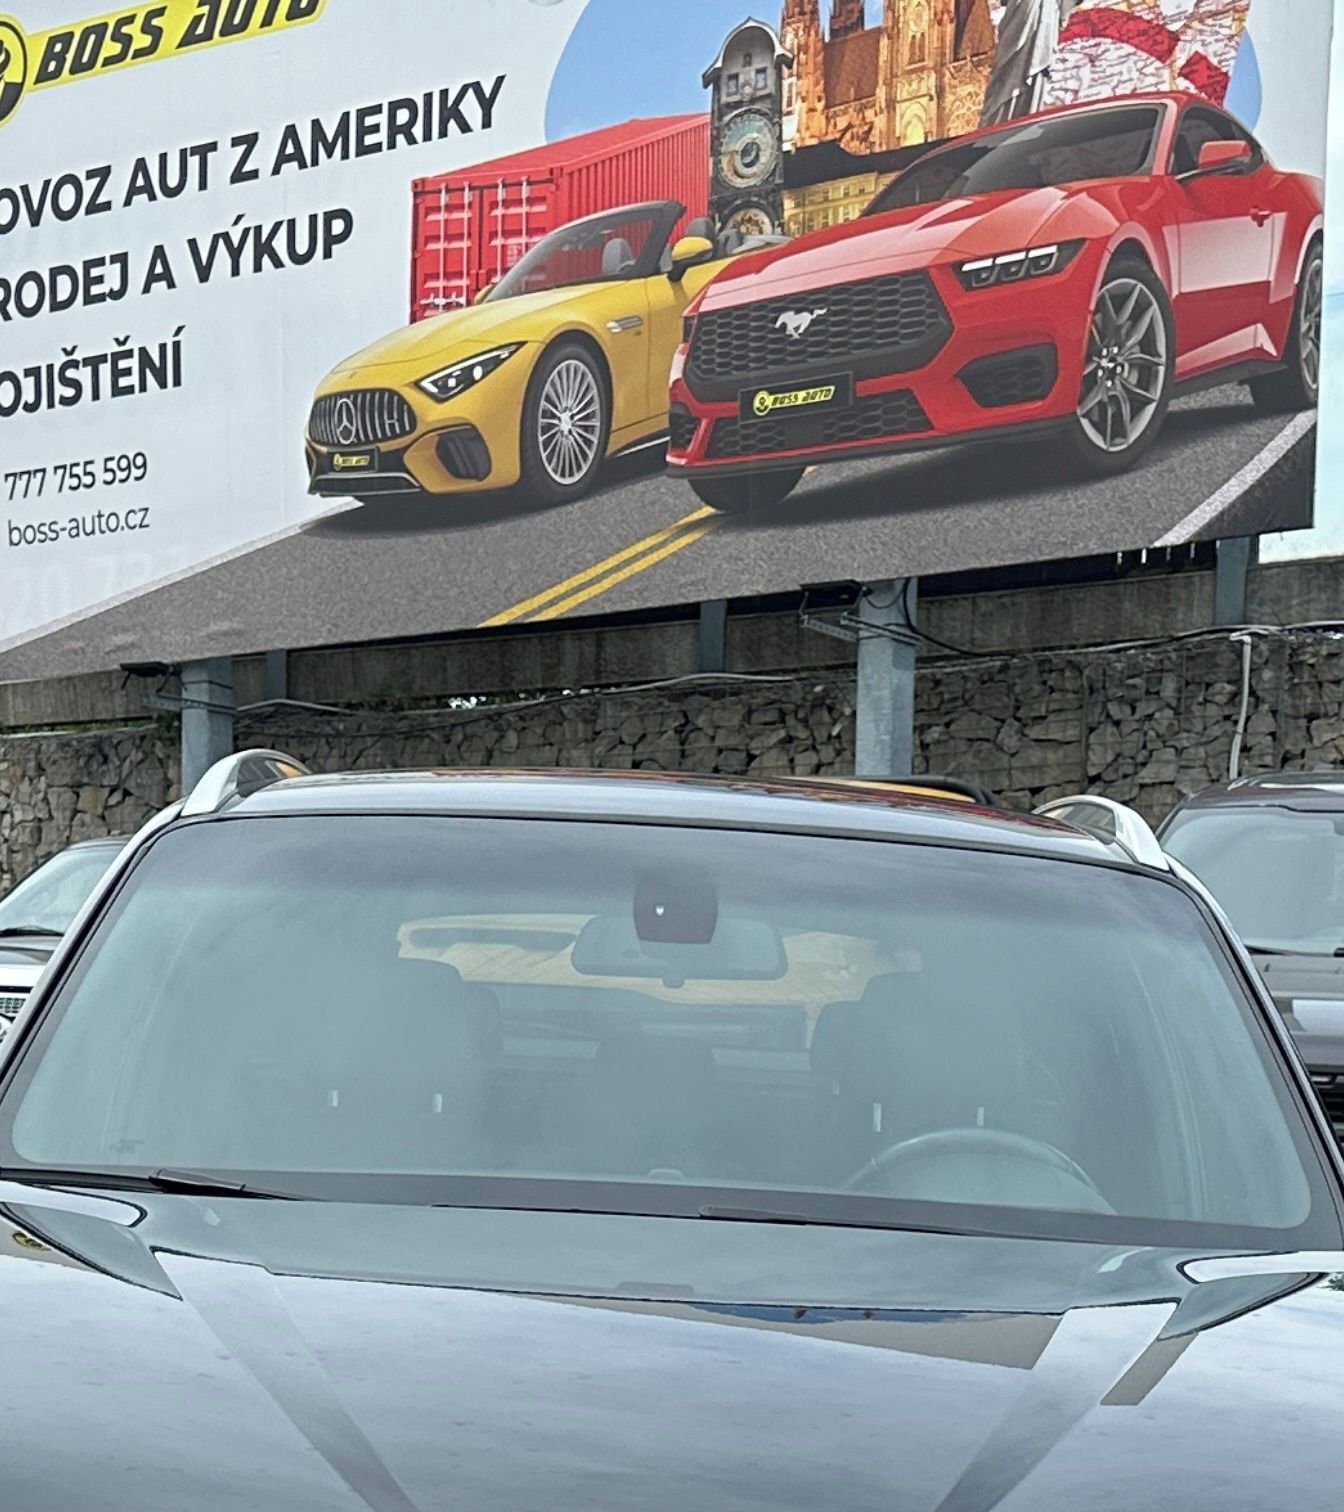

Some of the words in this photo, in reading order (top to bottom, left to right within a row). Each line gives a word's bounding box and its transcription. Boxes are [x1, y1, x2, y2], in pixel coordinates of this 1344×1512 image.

[33, 5, 168, 85] BOSS
[123, 142, 218, 207] AUT
[230, 132, 259, 184] Z
[271, 75, 506, 176] AMERIKY
[142, 245, 176, 294] A
[187, 208, 354, 284] VÝKUP
[4, 467, 47, 501] 777
[53, 460, 96, 494] 755
[102, 451, 148, 486] 599
[7, 507, 151, 547] boss-auto.cz
